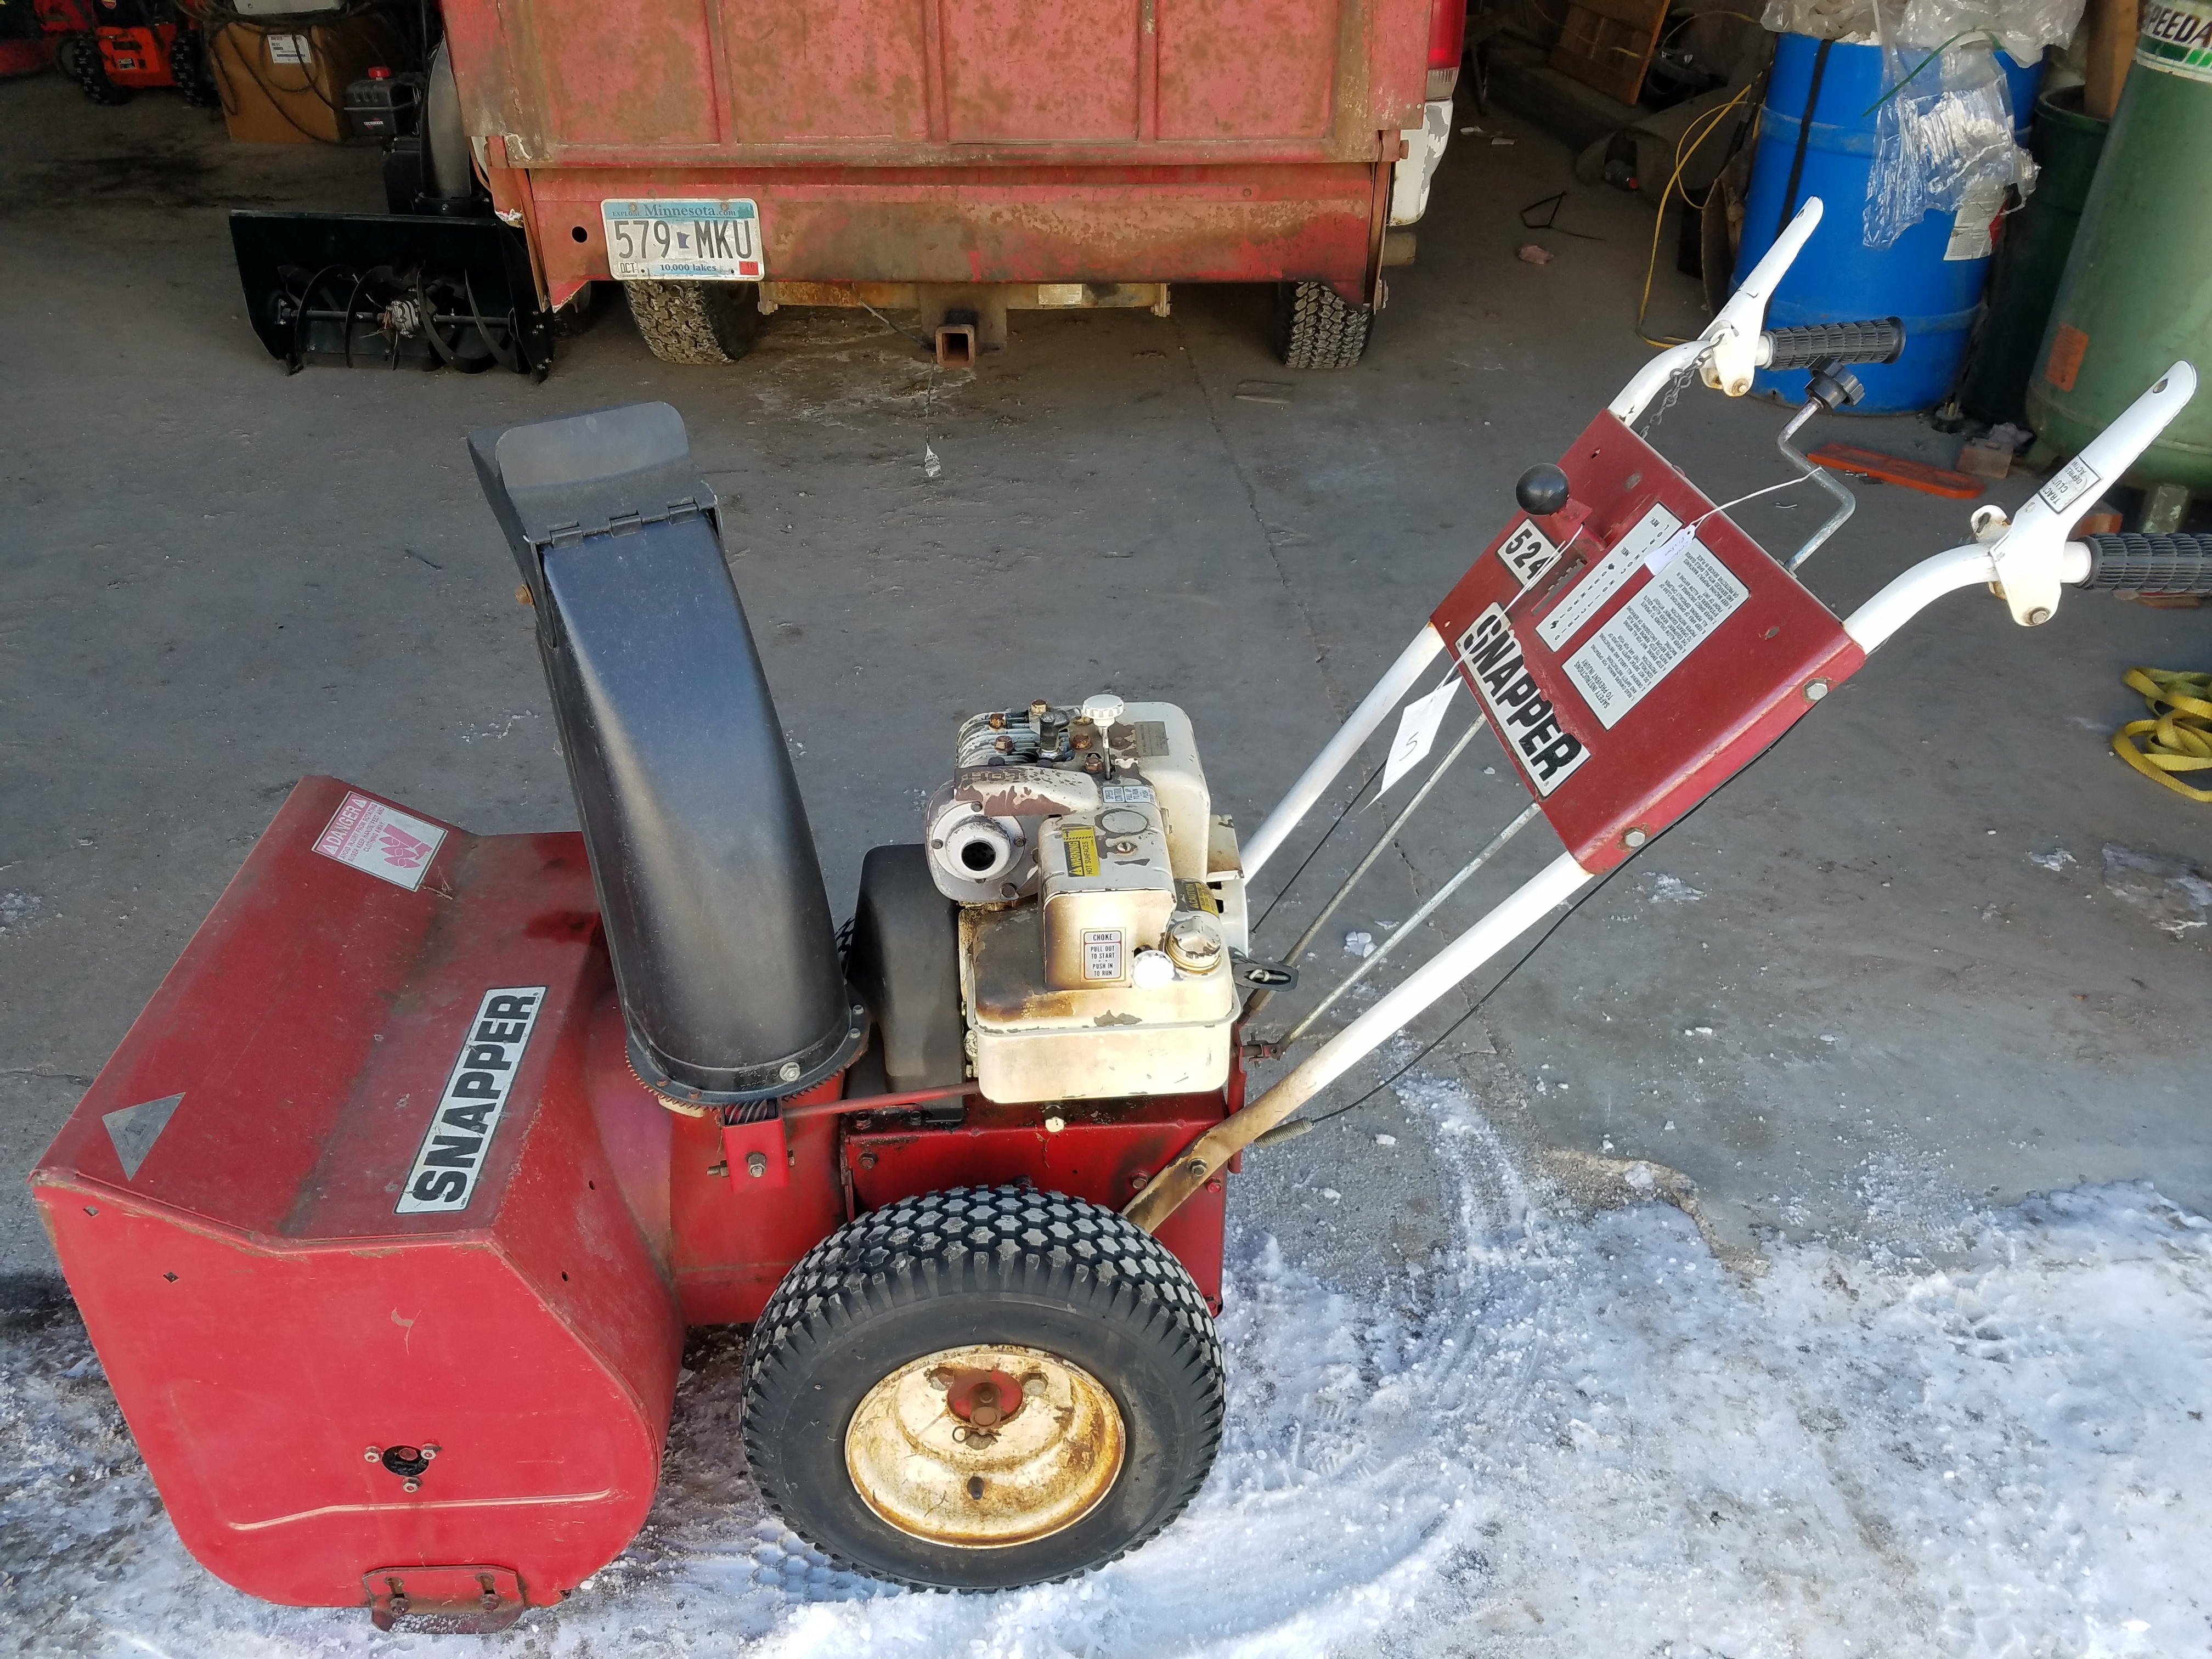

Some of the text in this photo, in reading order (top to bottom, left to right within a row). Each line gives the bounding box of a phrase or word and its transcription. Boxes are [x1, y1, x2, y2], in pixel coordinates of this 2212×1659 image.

[614, 220, 752, 258] 579 MKU
[620, 262, 634, 273] OCT
[692, 263, 716, 272] lakes
[1505, 528, 1555, 580] 524
[1464, 614, 1582, 781] SNAPPER
[1581, 657, 1613, 701] TO PREVENT INJURY
[1594, 689, 1610, 709] SAFETY
[325, 804, 362, 846] DANGER
[339, 803, 377, 859] AVOID INJURY FROM ROTATING
[356, 838, 366, 849] KEEP
[370, 814, 380, 824] FEET
[376, 806, 385, 815] AND
[363, 832, 379, 852] CLOTHING
[1069, 841, 1082, 867] WARNING
[1082, 841, 1091, 864] SURFACES
[1186, 884, 1198, 904] CAUTION
[413, 994, 535, 1203] SNAPPER
